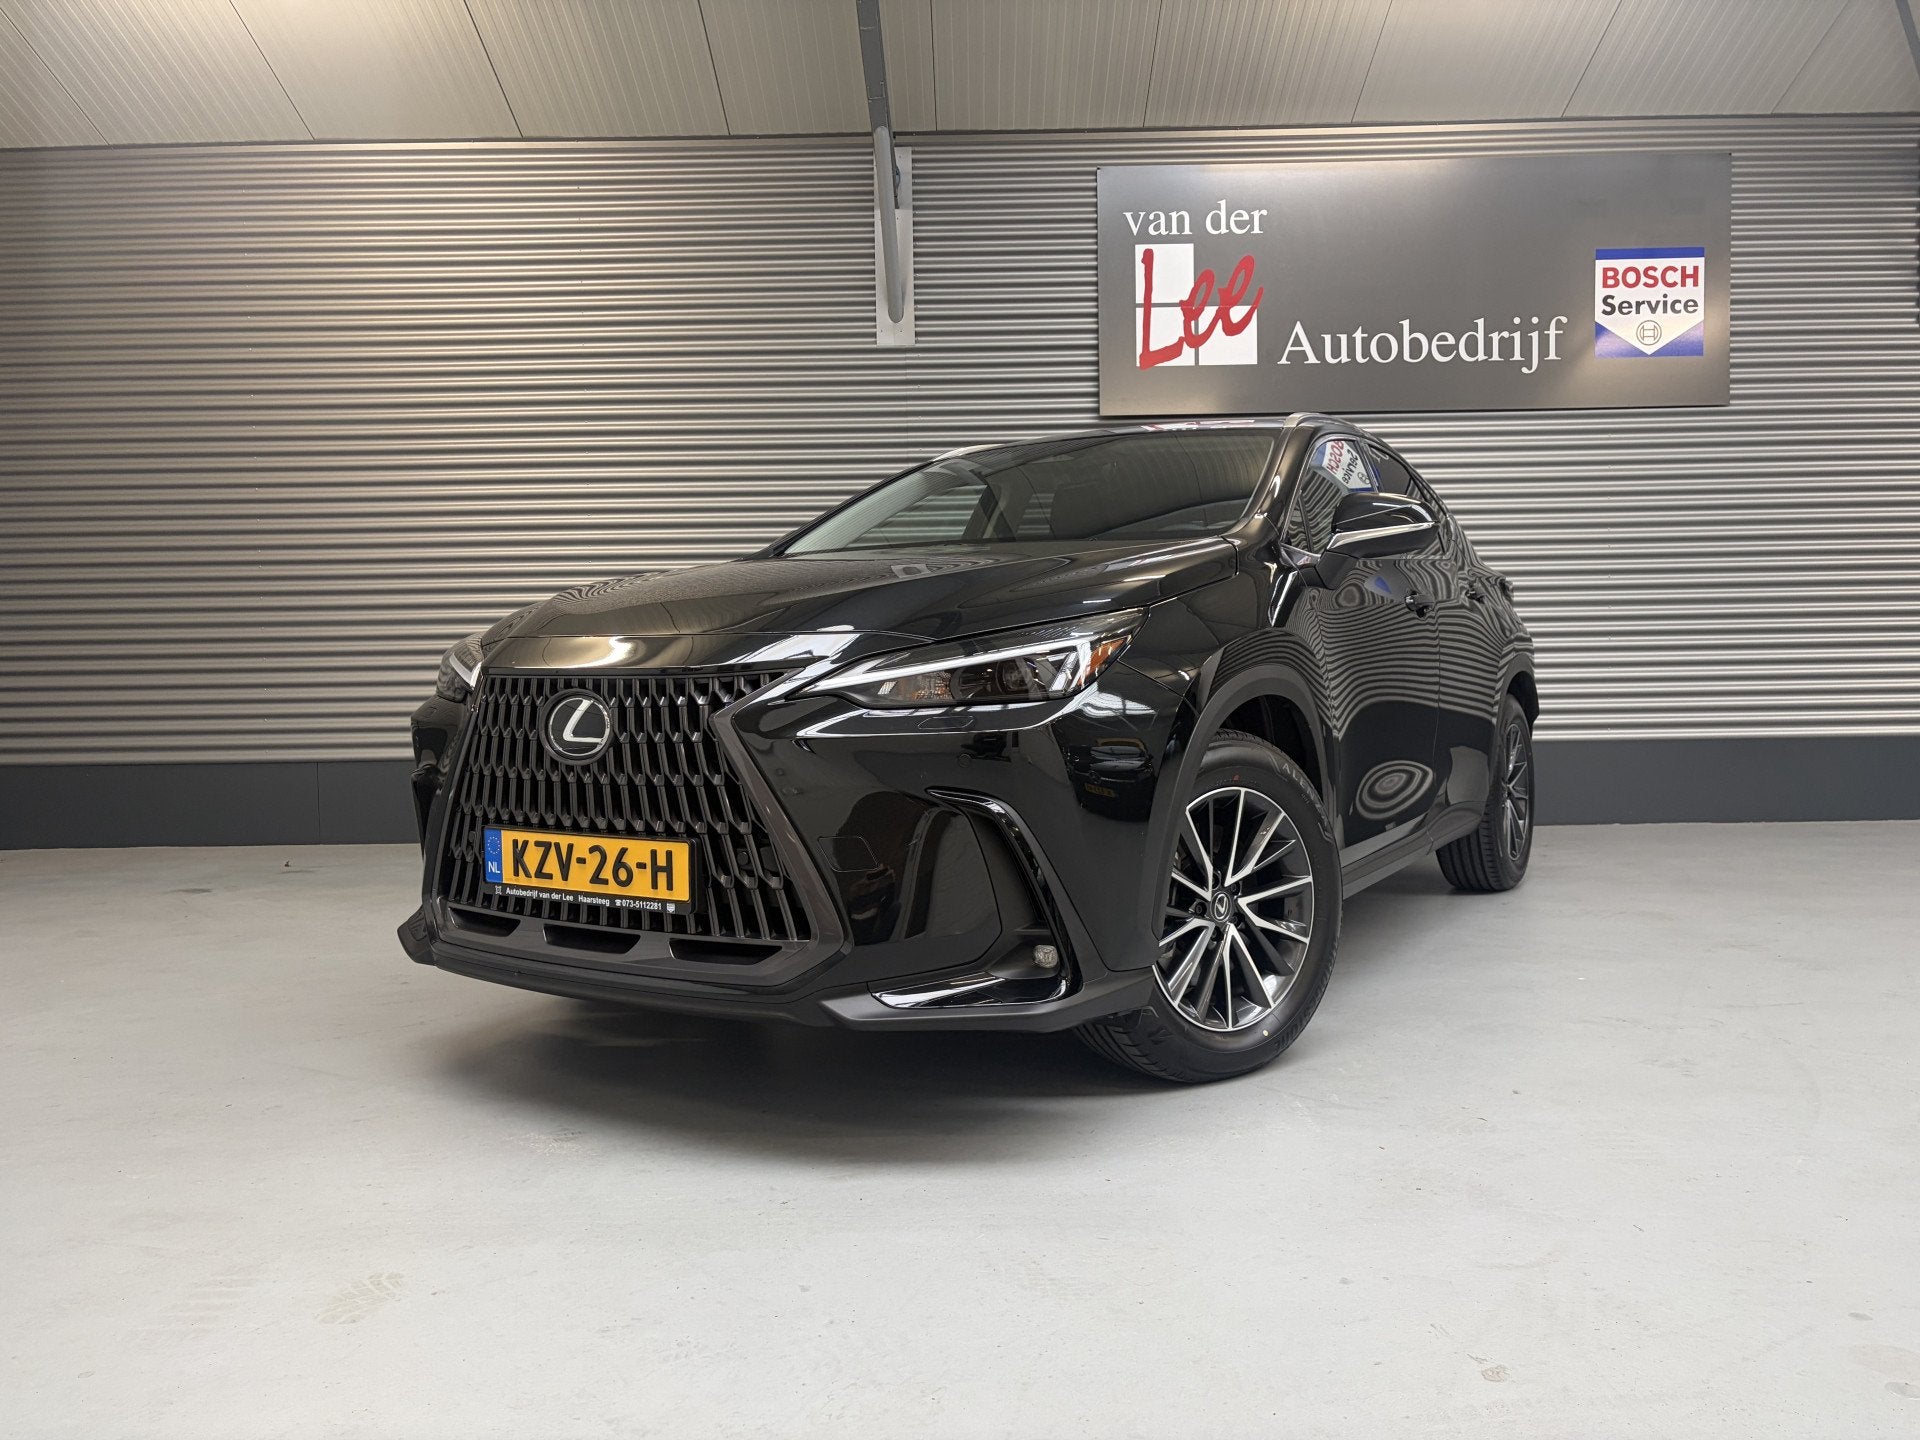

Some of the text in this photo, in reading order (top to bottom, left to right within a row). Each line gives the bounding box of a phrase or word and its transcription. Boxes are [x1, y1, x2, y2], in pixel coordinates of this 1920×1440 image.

[1123, 199, 1268, 236] van der
[1602, 265, 1699, 288] BOSCH
[1139, 248, 1265, 370] Lee
[1601, 293, 1699, 316] Service
[1277, 316, 1568, 374] Autobedrijf
[488, 861, 501, 874] NL
[512, 838, 674, 892] KZV-26-H
[505, 887, 538, 899] Autobedrijf
[539, 892, 550, 900] van
[551, 891, 561, 900] der
[562, 893, 574, 902] Lee
[578, 894, 610, 907] Haarsteeg
